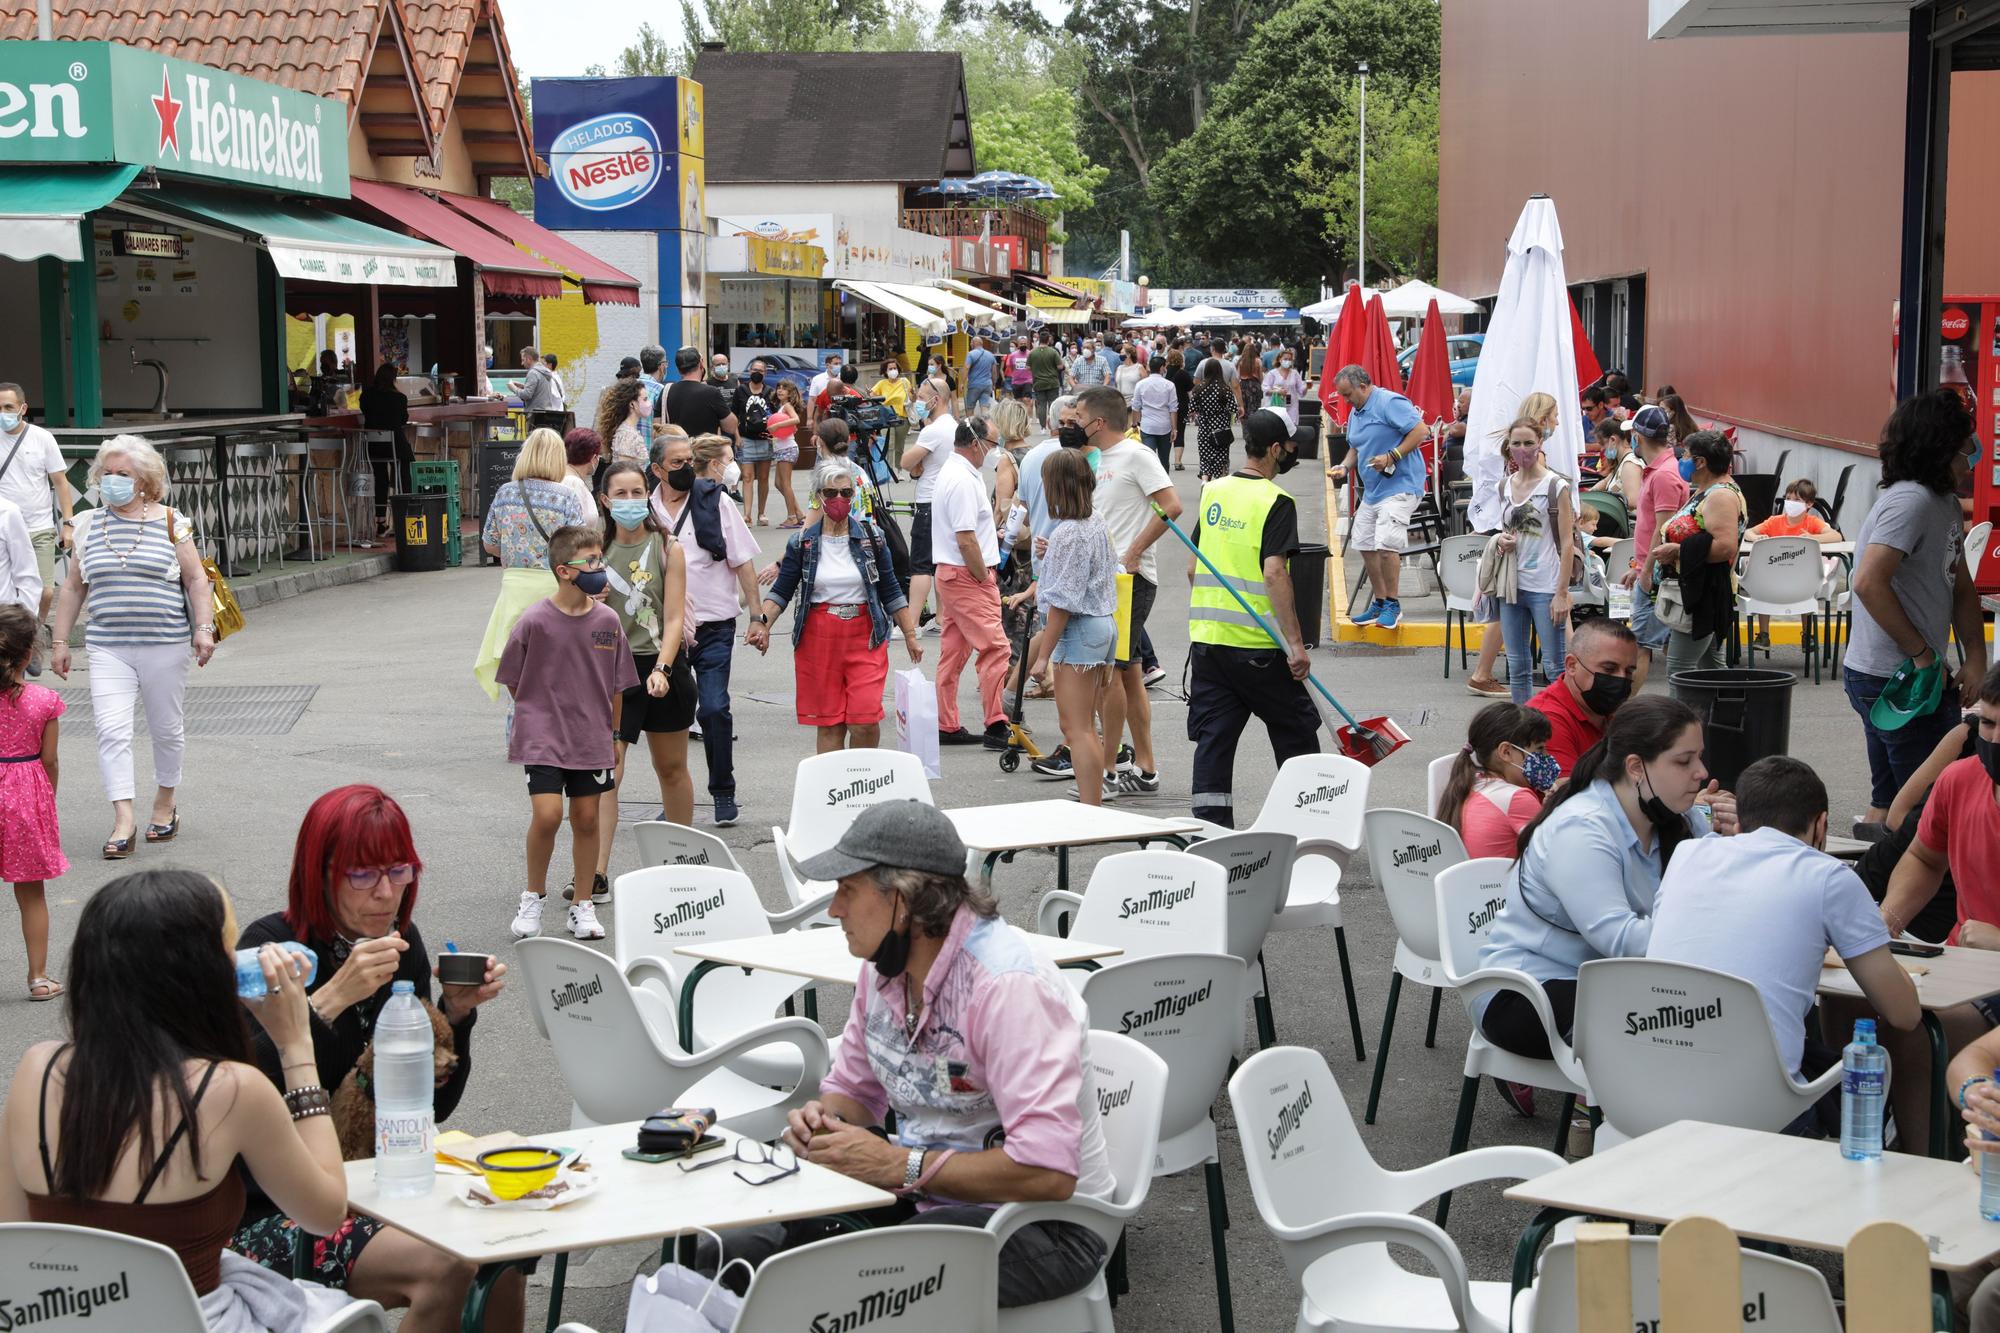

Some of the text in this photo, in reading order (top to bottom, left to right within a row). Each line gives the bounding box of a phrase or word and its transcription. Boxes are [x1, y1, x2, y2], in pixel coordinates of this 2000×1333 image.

[186, 74, 322, 184] Heineken
[566, 120, 634, 149] HELADOS
[569, 145, 651, 191] Nestlé
[124, 235, 160, 253] CALAMARES
[160, 240, 181, 255] FRITOS
[1190, 296, 1265, 304] RESTAURANTE
[1768, 547, 1806, 565] SanMiguel
[827, 769, 894, 805] SanMiguel
[1295, 779, 1349, 808] SanMiguel
[1393, 839, 1442, 867] SanMiguel
[654, 888, 725, 934] SanMiguel
[1118, 881, 1196, 919] SanMiguel
[551, 973, 603, 1011] SanMiguel
[1154, 979, 1185, 987] CERVEZAS
[1651, 986, 1687, 996] CERVEZAS
[1118, 979, 1213, 1035] SanMiguel
[1624, 997, 1722, 1036] SanMiguel
[1652, 1037, 1673, 1045] SINCE
[1267, 1080, 1312, 1160] SanMiguel
[29, 1261, 79, 1272] CERVEZAS
[858, 1265, 905, 1277] CERVEZAS
[0, 1271, 129, 1333] SanMiguel
[809, 1263, 945, 1333] SanMiguel
